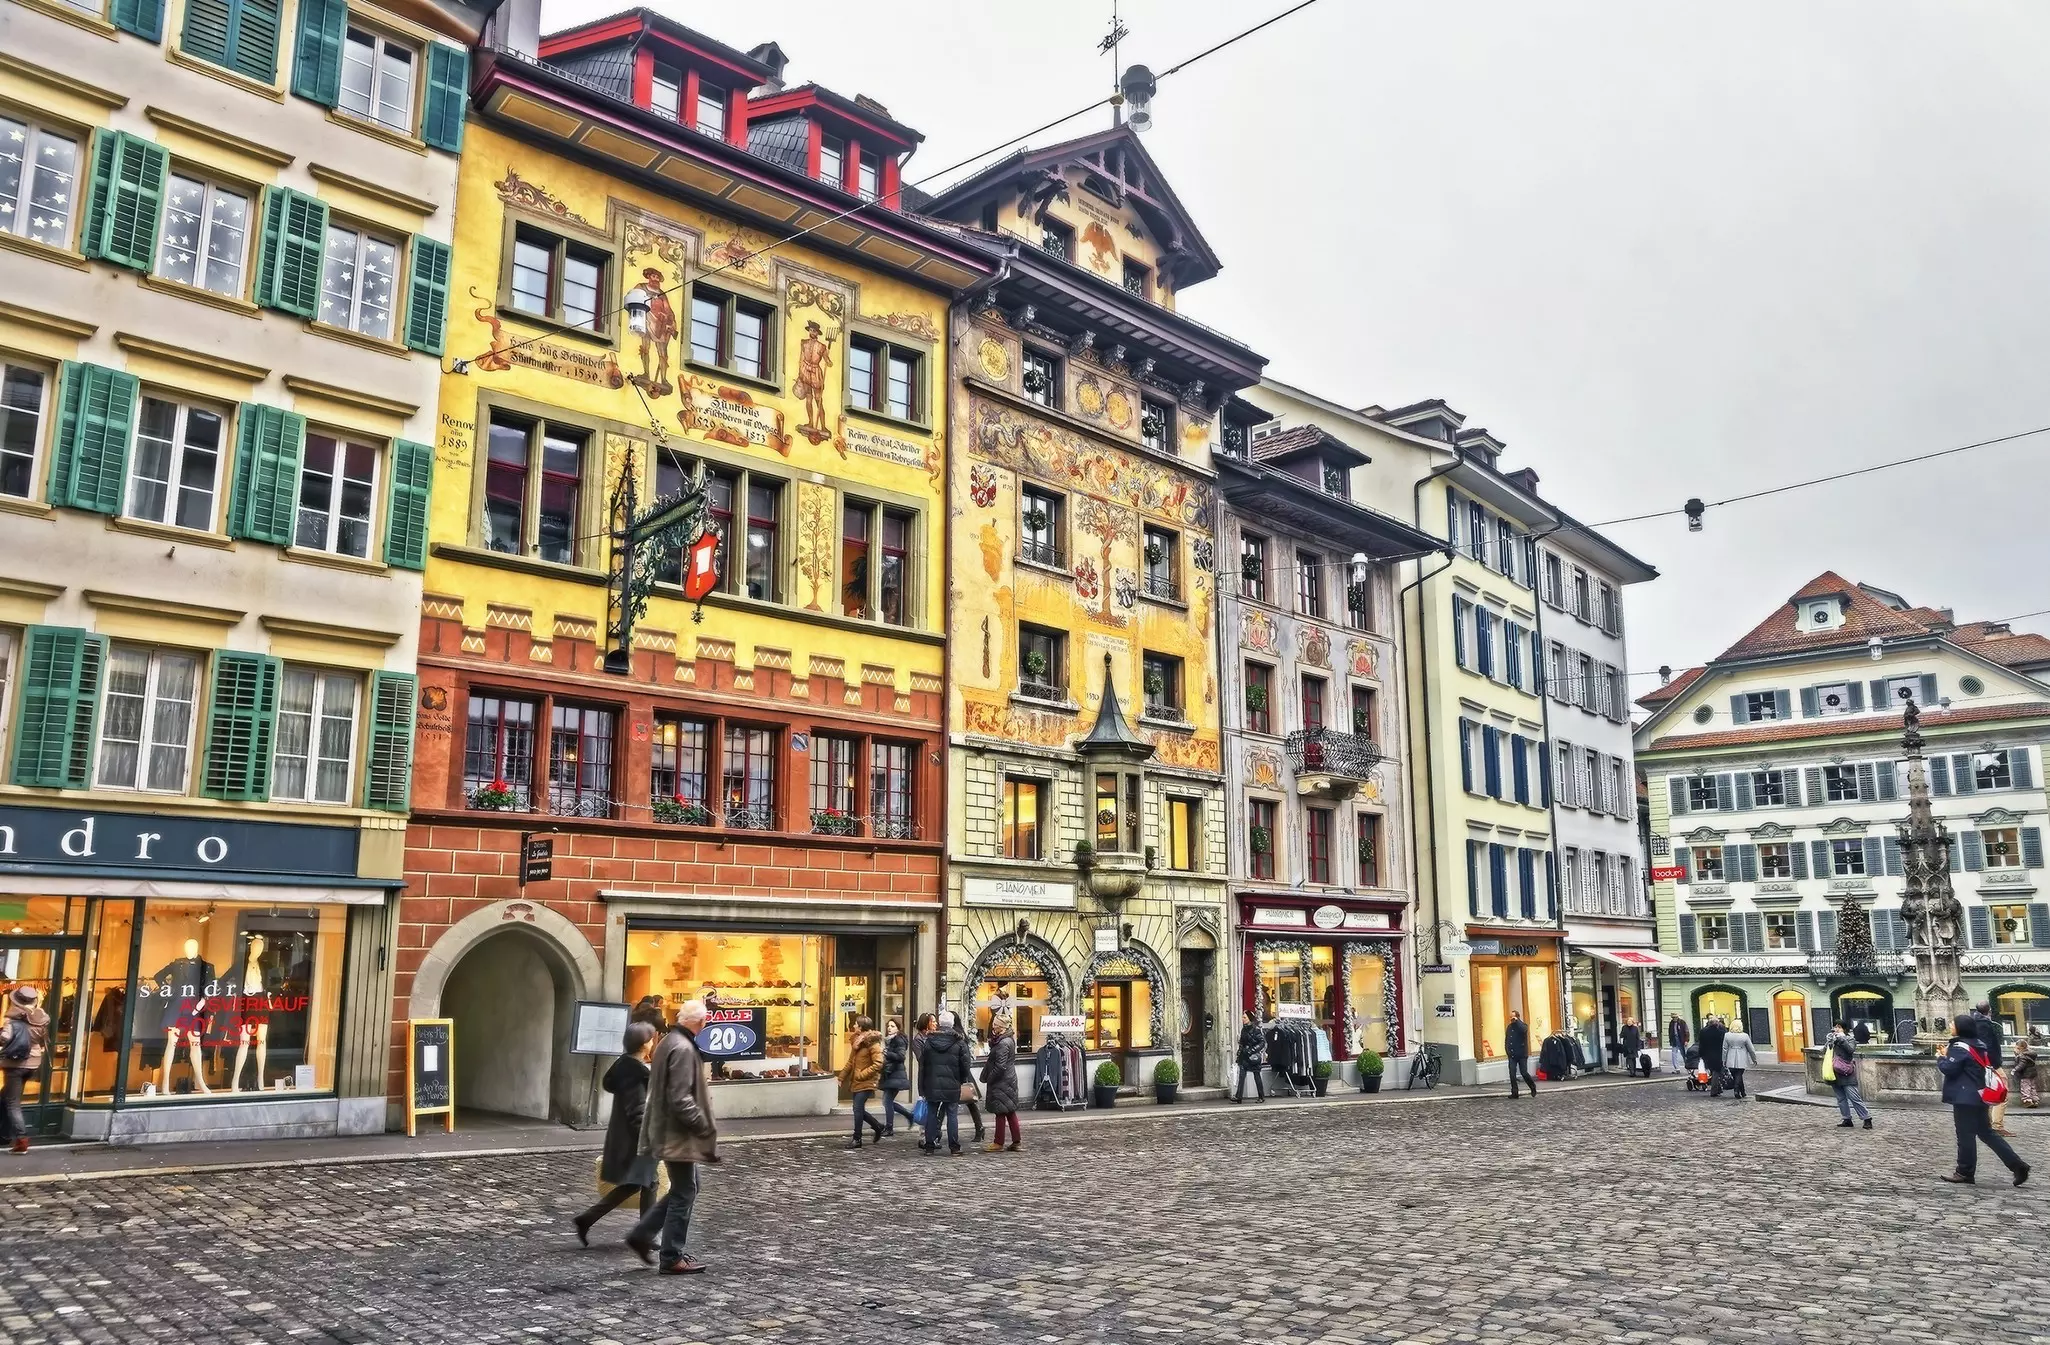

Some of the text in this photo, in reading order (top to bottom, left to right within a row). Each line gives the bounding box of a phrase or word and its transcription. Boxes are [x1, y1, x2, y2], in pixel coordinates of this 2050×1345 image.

[441, 413, 475, 431] Renov.
[442, 435, 468, 453] 1889
[1654, 869, 1683, 877] bodum
[1959, 954, 2022, 966] OKOLOV
[139, 979, 258, 998] sandro
[705, 1009, 752, 1023] SALE
